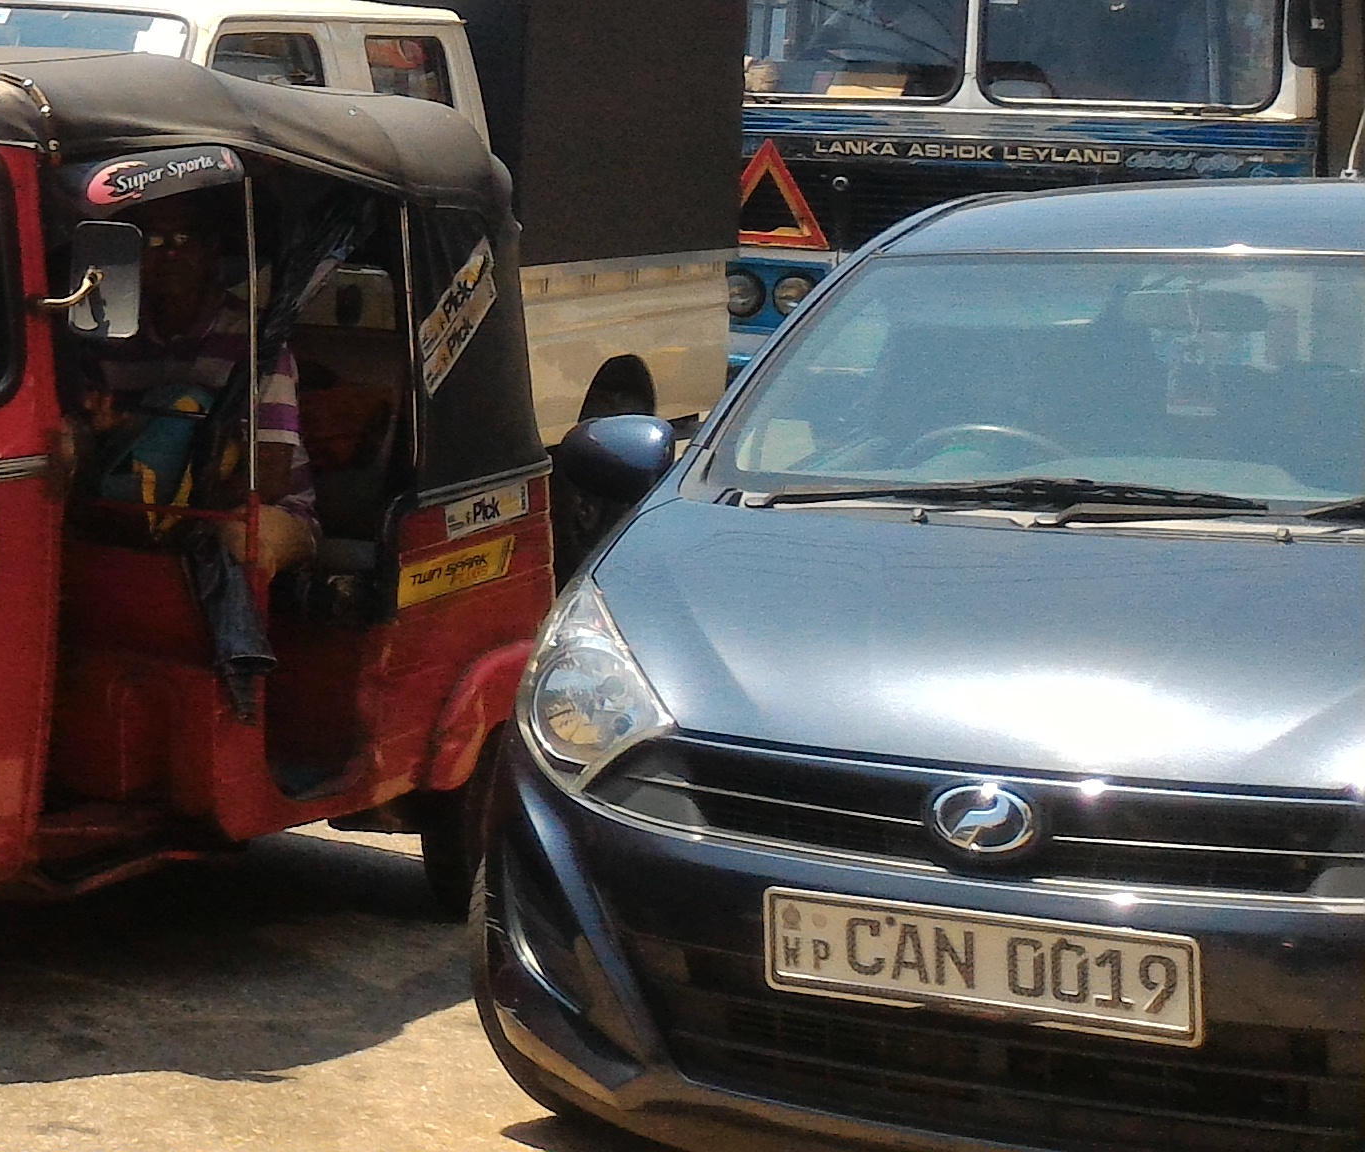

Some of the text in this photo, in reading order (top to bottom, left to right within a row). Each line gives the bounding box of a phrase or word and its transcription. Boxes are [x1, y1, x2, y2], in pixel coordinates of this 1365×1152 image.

[814, 140, 898, 157] LANKA
[908, 142, 993, 160] ASHOK
[1003, 146, 1122, 165] LEYLAND
[116, 155, 214, 194] Super Sports
[473, 496, 501, 523] Pick
[409, 552, 490, 586] TWIN SPARK
[781, 934, 832, 970] WP
[845, 916, 1178, 1015] CAN 0019
